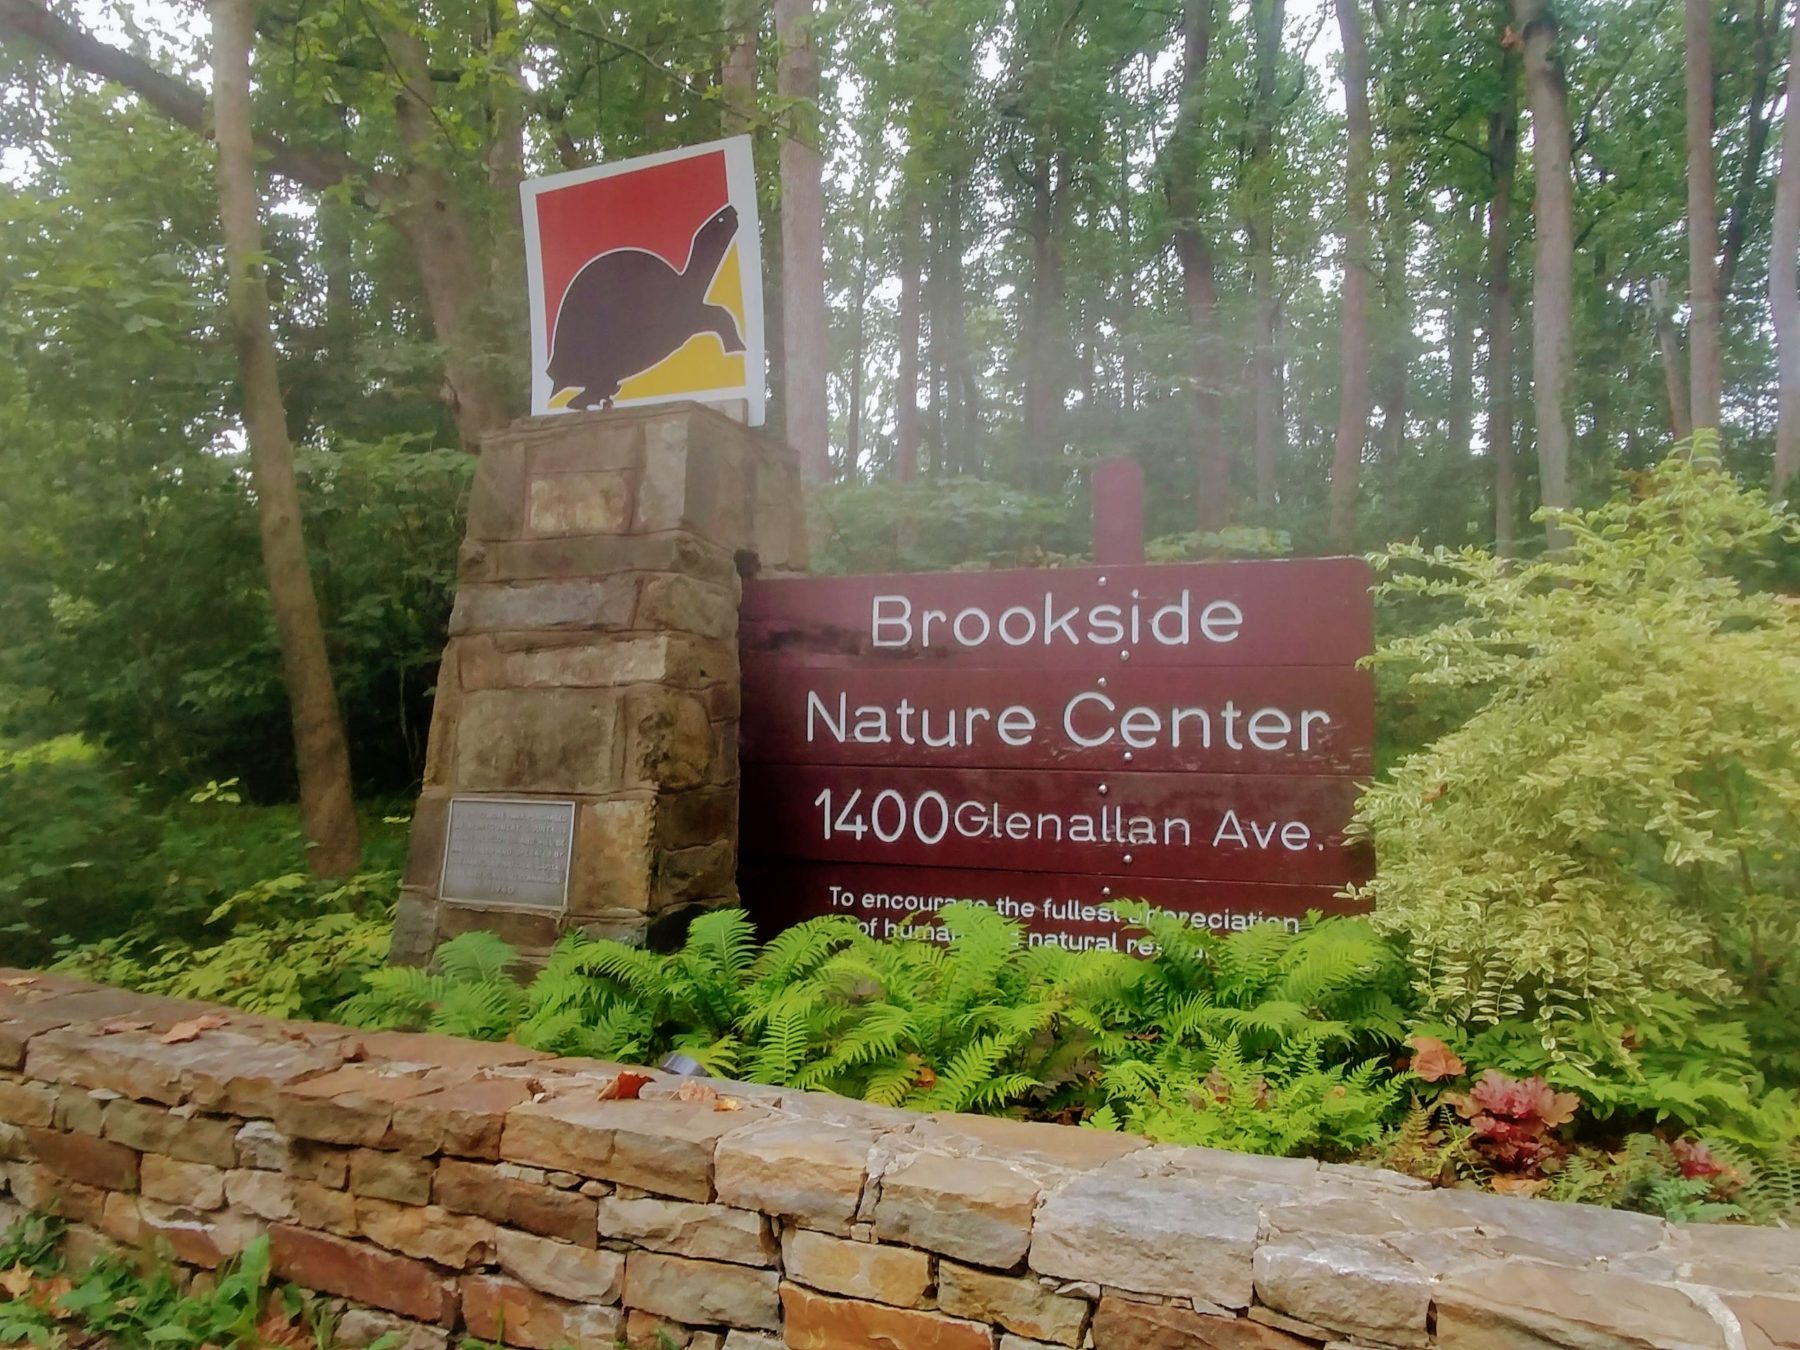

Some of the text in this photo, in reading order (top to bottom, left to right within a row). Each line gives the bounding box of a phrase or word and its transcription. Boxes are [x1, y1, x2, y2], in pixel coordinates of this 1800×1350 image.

[871, 589, 1244, 648] Brookside
[806, 690, 1331, 752] Nature Center
[814, 787, 1325, 852] 1400 Glenallan Ave.
[829, 886, 854, 907] To
[861, 892, 989, 912] encourae
[995, 896, 1035, 917] the
[1043, 898, 1121, 922] fullest
[858, 917, 878, 937] of
[884, 918, 957, 942] huma
[1028, 931, 1119, 952] natural
